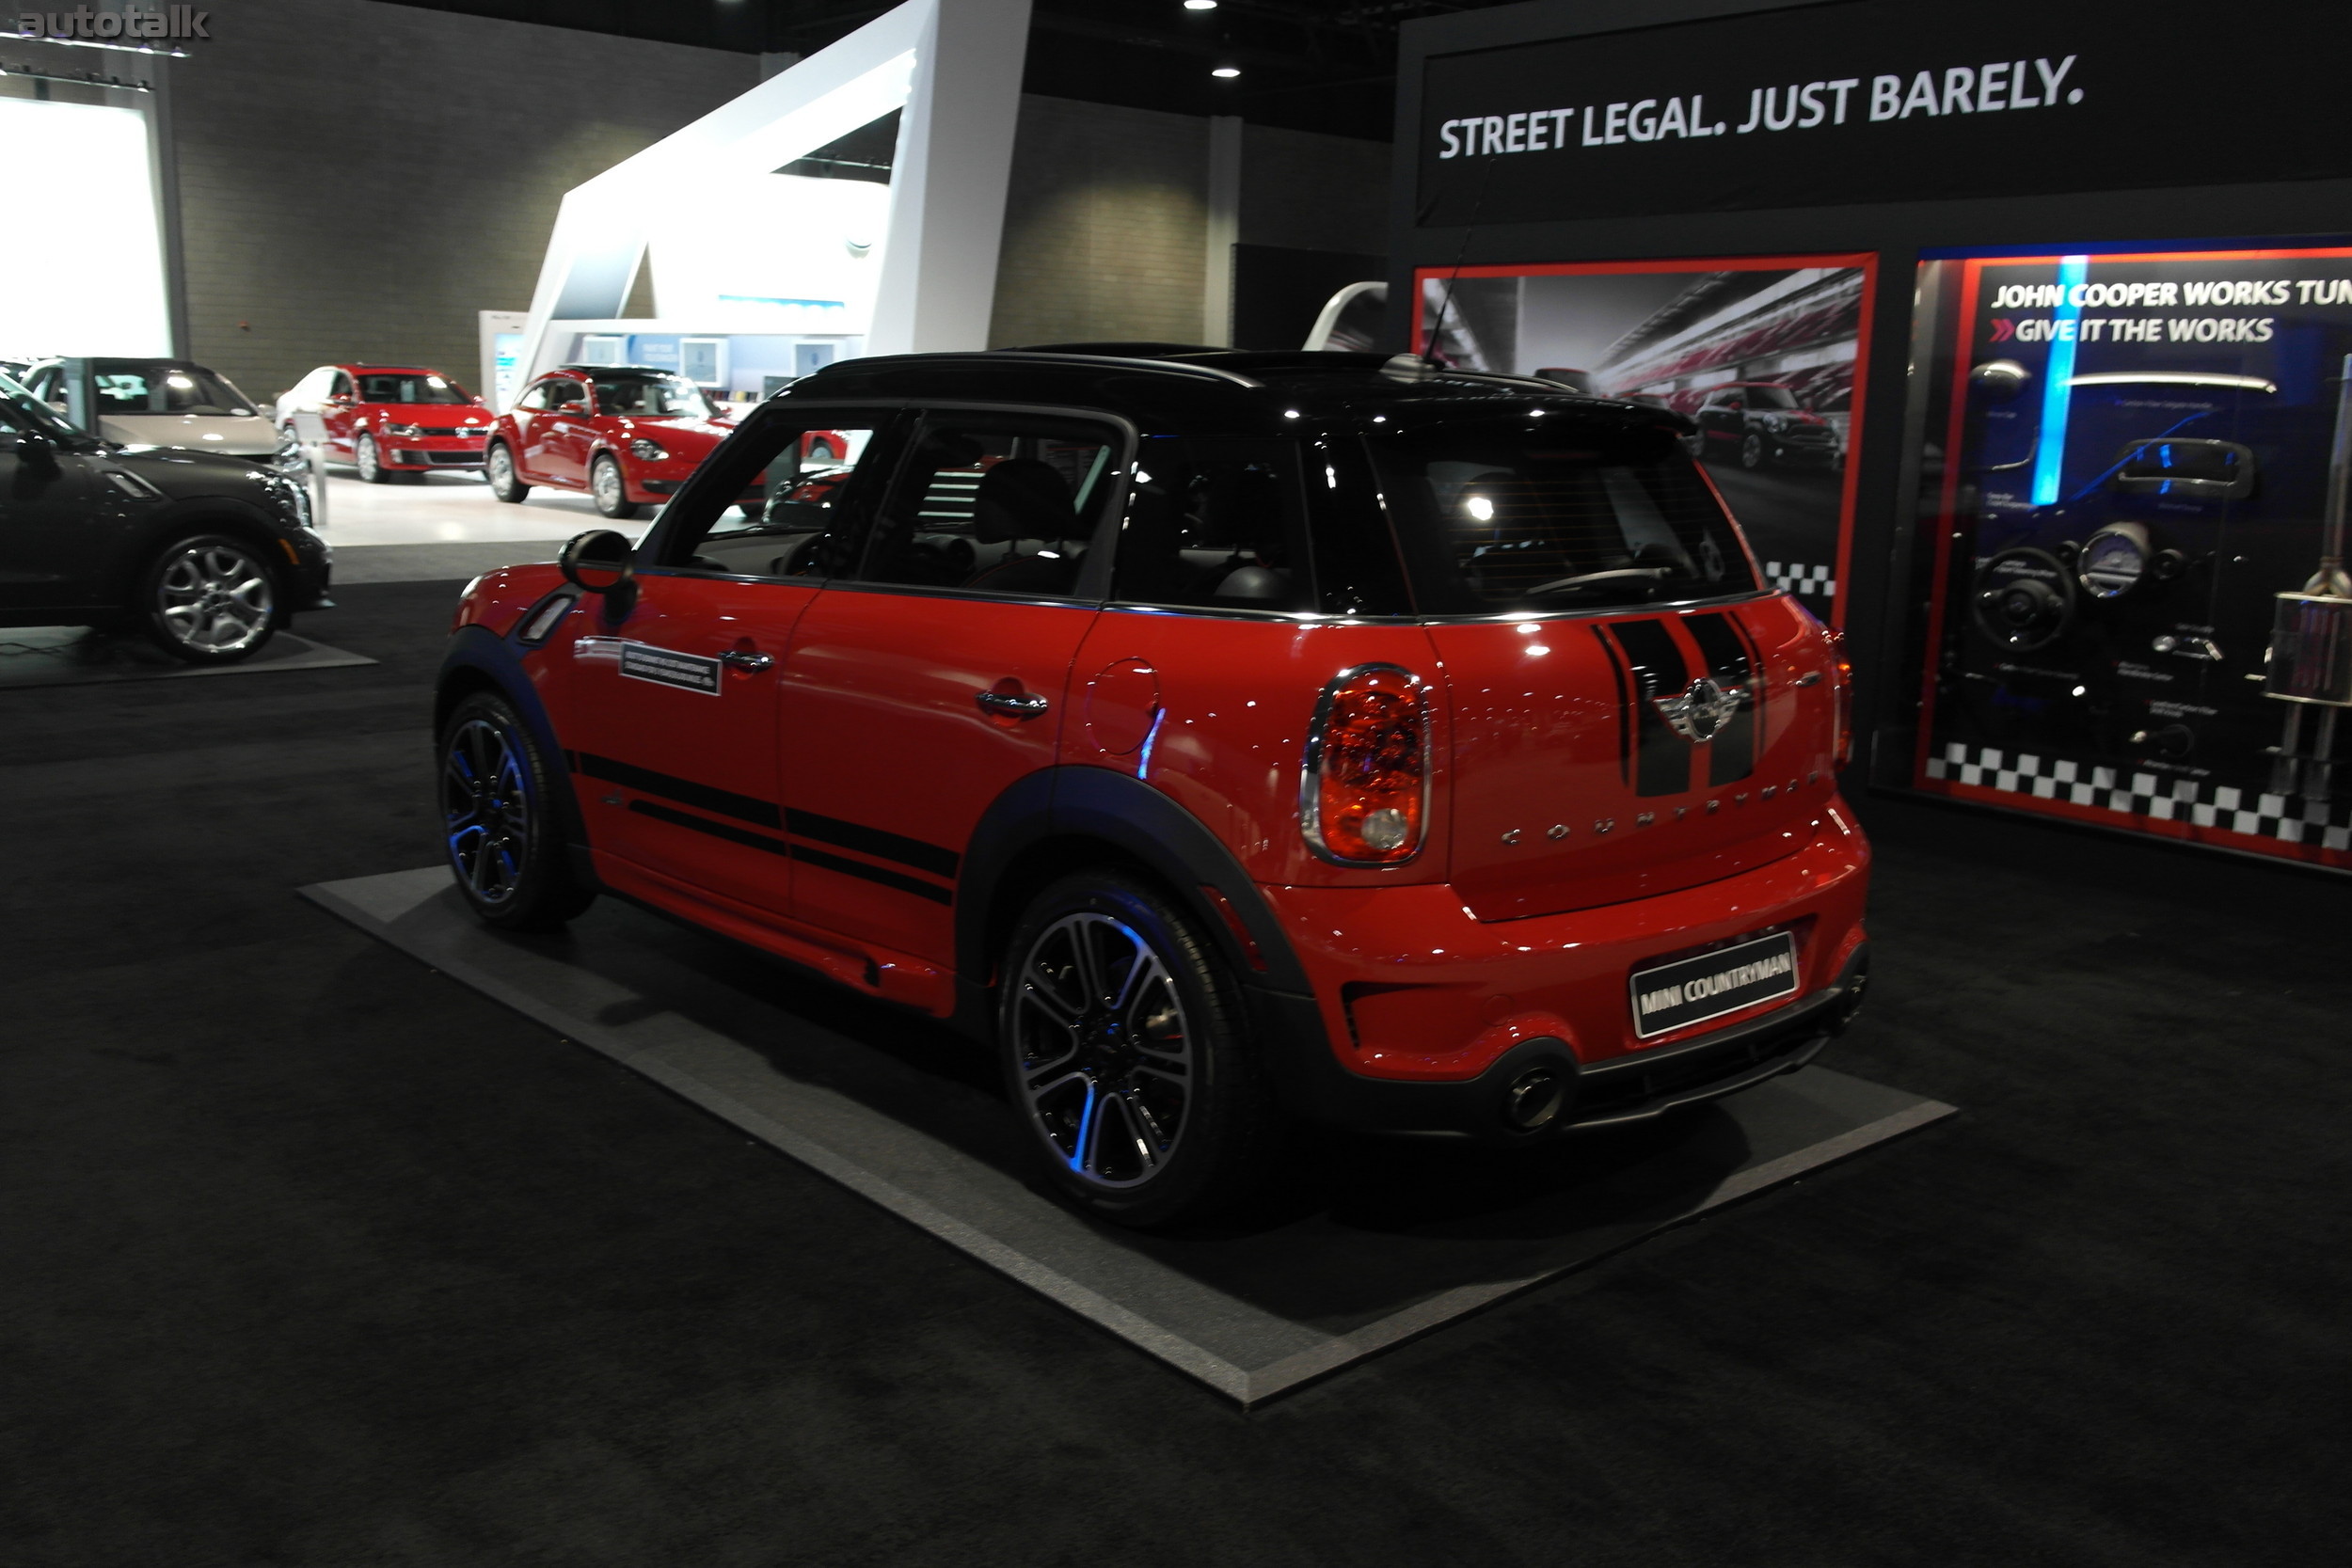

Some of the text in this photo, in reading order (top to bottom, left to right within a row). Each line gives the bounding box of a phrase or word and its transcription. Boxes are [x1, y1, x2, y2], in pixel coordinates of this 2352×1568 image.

[1438, 55, 2085, 159] STREET LEGAL. JUST BARELY.
[1990, 284, 2067, 309] JOHN
[2067, 282, 2178, 309] COOPER
[2183, 279, 2292, 307] WORKS
[2014, 317, 2275, 343] GIVE IT THE WORKS
[1640, 951, 1791, 1016] MINI COUNTRYMAN
